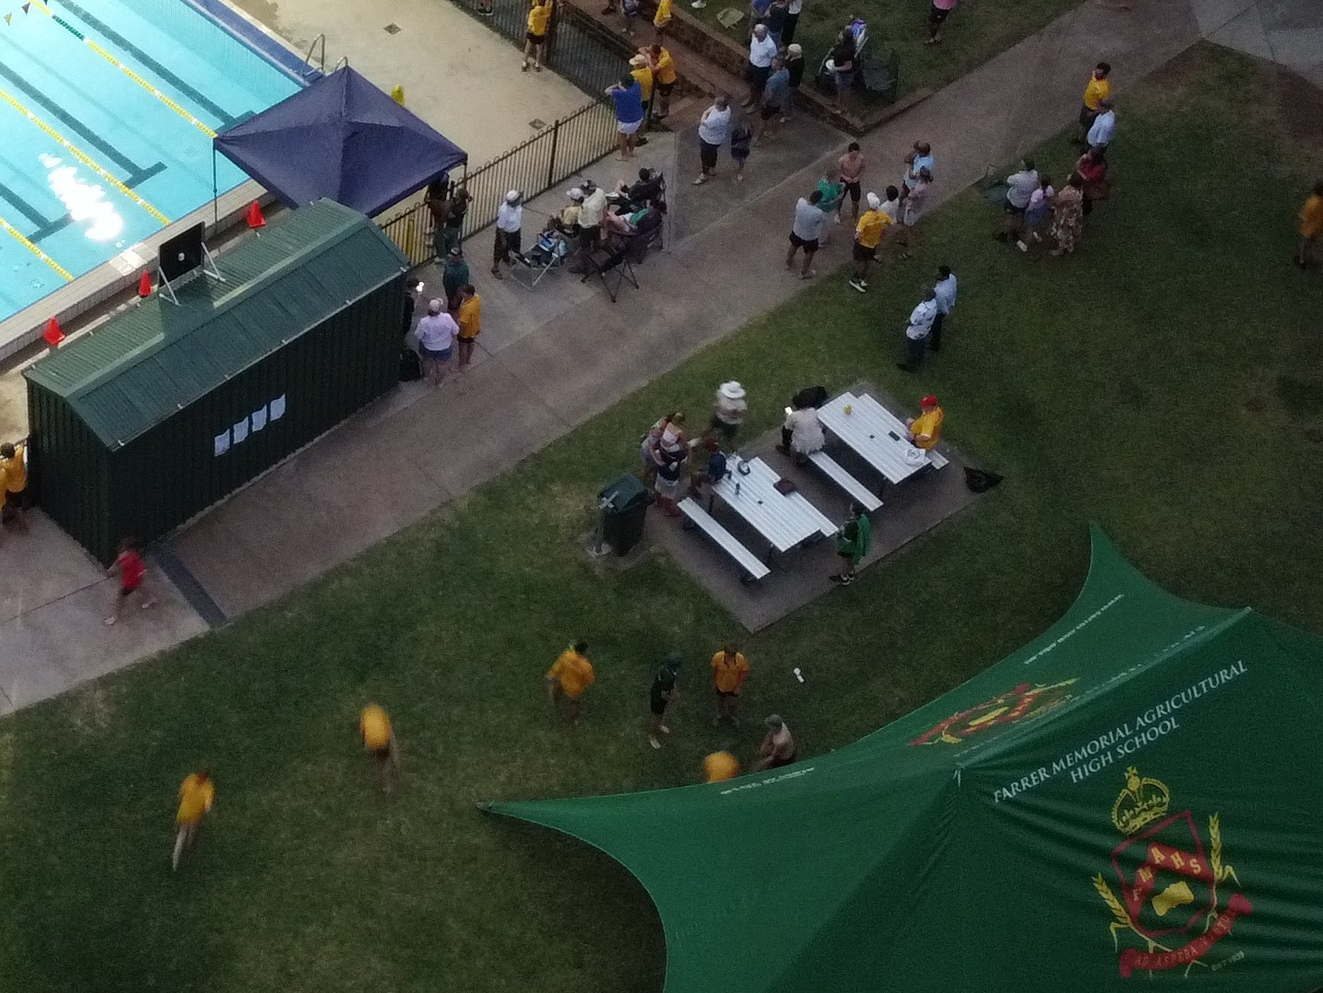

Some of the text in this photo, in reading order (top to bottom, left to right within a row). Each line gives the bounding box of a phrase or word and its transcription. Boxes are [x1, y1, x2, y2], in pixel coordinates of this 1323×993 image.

[993, 660, 1248, 804] FARRER MEMORIAL AGRICULTURAL
[1070, 716, 1180, 784] HIGH SCHOOL
